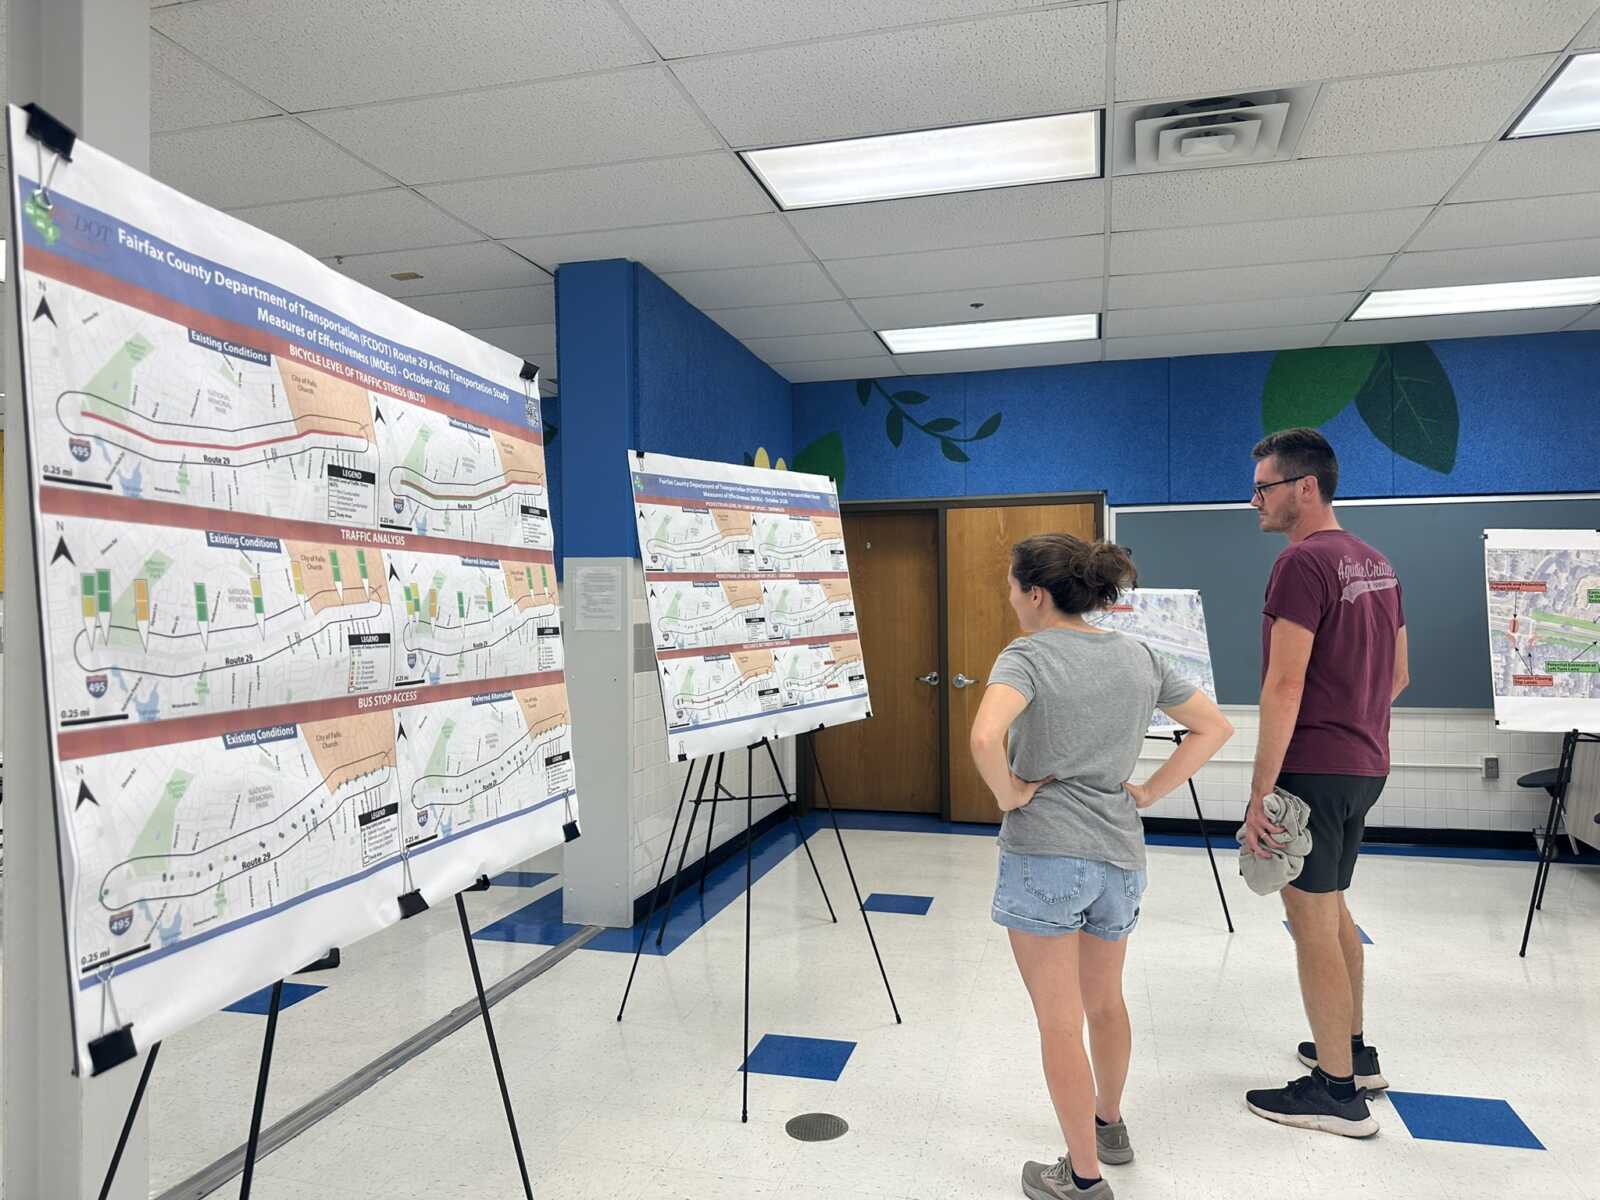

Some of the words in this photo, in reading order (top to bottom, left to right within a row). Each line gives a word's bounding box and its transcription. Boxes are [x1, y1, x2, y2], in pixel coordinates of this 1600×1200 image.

[117, 227, 164, 263] Fairfax
[166, 251, 212, 284] County
[214, 270, 287, 310] Department
[288, 299, 299, 314] of
[299, 304, 360, 343] Transportation
[360, 334, 392, 358] (FCDOT)
[393, 346, 417, 365] Route
[417, 356, 428, 369] 29
[428, 362, 450, 378] Active
[449, 369, 493, 396] Transportation
[492, 387, 510, 404] Study
[191, 330, 222, 352] Existing
[223, 342, 268, 363] Conditions
[257, 307, 305, 338] Measures
[307, 328, 318, 343] of
[318, 332, 369, 364] Effectiveness
[369, 357, 397, 376] (MOEs)
[402, 367, 433, 387] October
[289, 344, 322, 367] BICYCLE
[322, 357, 344, 376] LEVEL
[344, 366, 355, 378] OF
[355, 370, 382, 390] TRAFFIC
[383, 381, 406, 398] STRESS
[407, 389, 426, 405] (BLTS)
[203, 455, 219, 465] Route
[219, 456, 230, 465] 29
[43, 464, 61, 475] 0.25
[62, 467, 72, 477] mi
[56, 521, 64, 531] N
[209, 535, 239, 549] Existing
[239, 536, 279, 550] Conditions
[340, 529, 371, 541] TRAFFIC
[372, 533, 405, 546] ANALYSIS
[225, 656, 243, 665] Route
[244, 654, 253, 662] 29
[88, 682, 105, 692] 495
[358, 697, 373, 709] BUS
[374, 695, 391, 706] STOP
[392, 692, 417, 703] ACCESS
[61, 710, 79, 719] 0.25
[80, 708, 90, 717] mi
[226, 732, 257, 745] Existing
[257, 727, 295, 741] Conditions
[241, 857, 262, 870] Route
[263, 851, 271, 862] 29
[111, 916, 130, 932] 495
[81, 953, 99, 966] 0.25
[99, 949, 111, 960] mi
